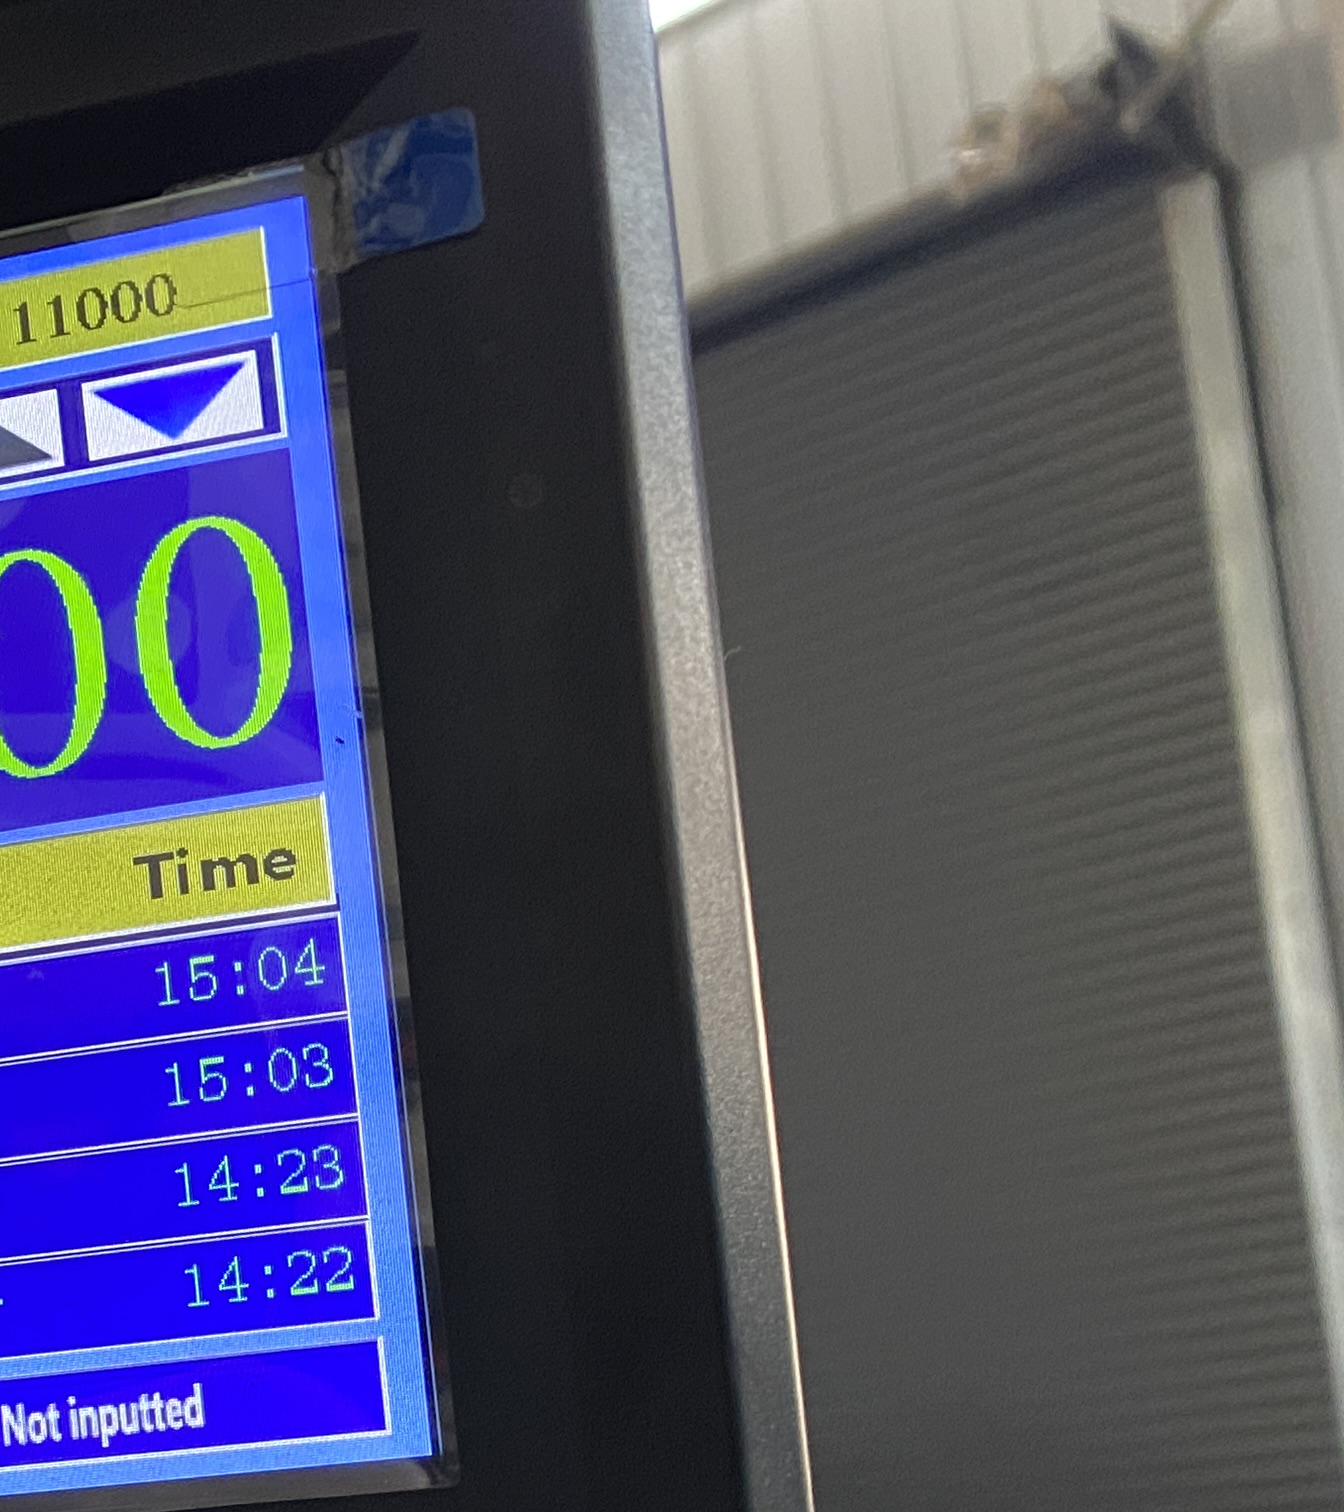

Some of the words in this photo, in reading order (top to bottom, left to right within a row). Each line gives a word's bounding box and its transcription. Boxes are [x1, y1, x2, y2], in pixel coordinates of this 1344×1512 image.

[10, 272, 178, 348] 11000
[134, 843, 299, 903] Time
[153, 940, 327, 1008] 15:04
[163, 1043, 335, 1108] 15:03
[173, 1144, 346, 1209] 14:23
[183, 1246, 357, 1309] 14:22
[2, 1398, 61, 1446] Not
[69, 1382, 206, 1445] inputted
